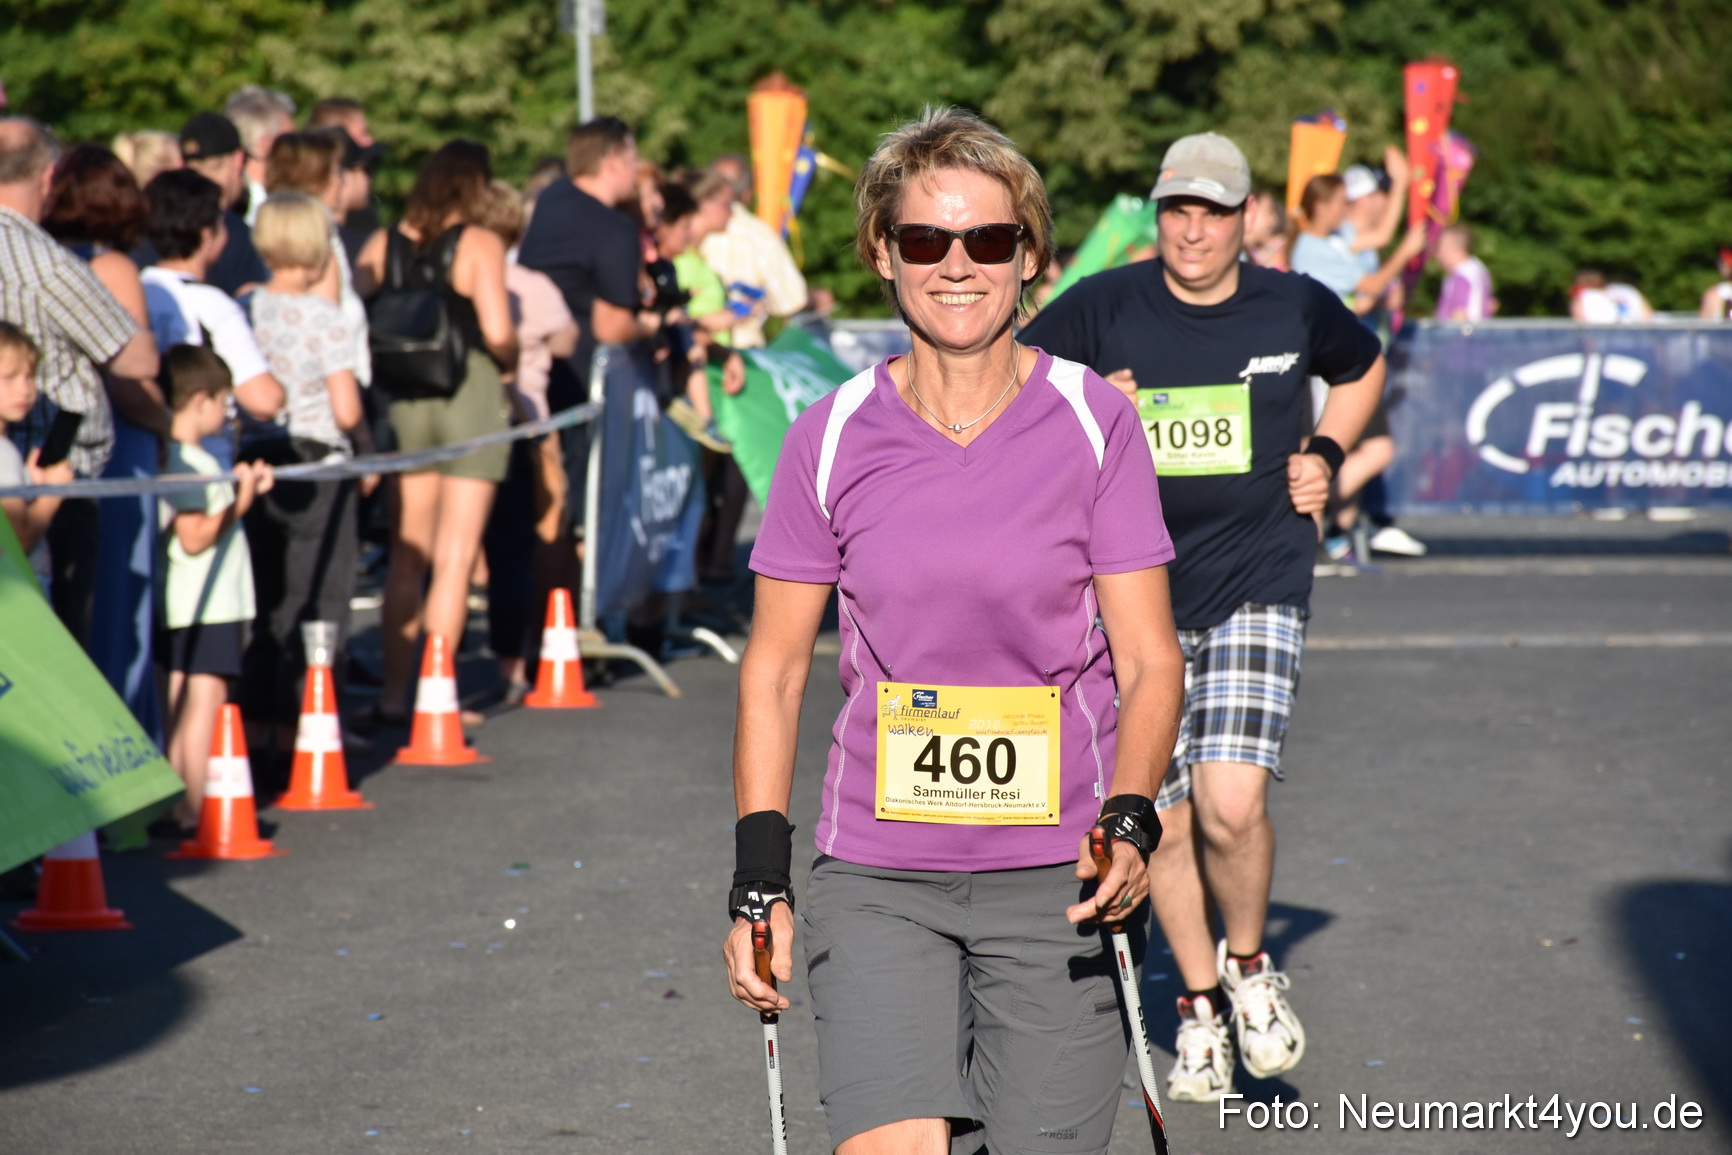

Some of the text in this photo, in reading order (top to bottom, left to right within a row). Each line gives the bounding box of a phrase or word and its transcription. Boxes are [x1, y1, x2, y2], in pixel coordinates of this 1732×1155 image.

[1148, 418, 1233, 449] 1098
[901, 705, 961, 719] firmenlauf
[888, 723, 934, 737] walken
[913, 735, 1017, 785] 460
[913, 785, 1020, 800] Sammüller Resi
[885, 796, 926, 806] Diakonisches
[1049, 1132, 1078, 1140] ROSSI
